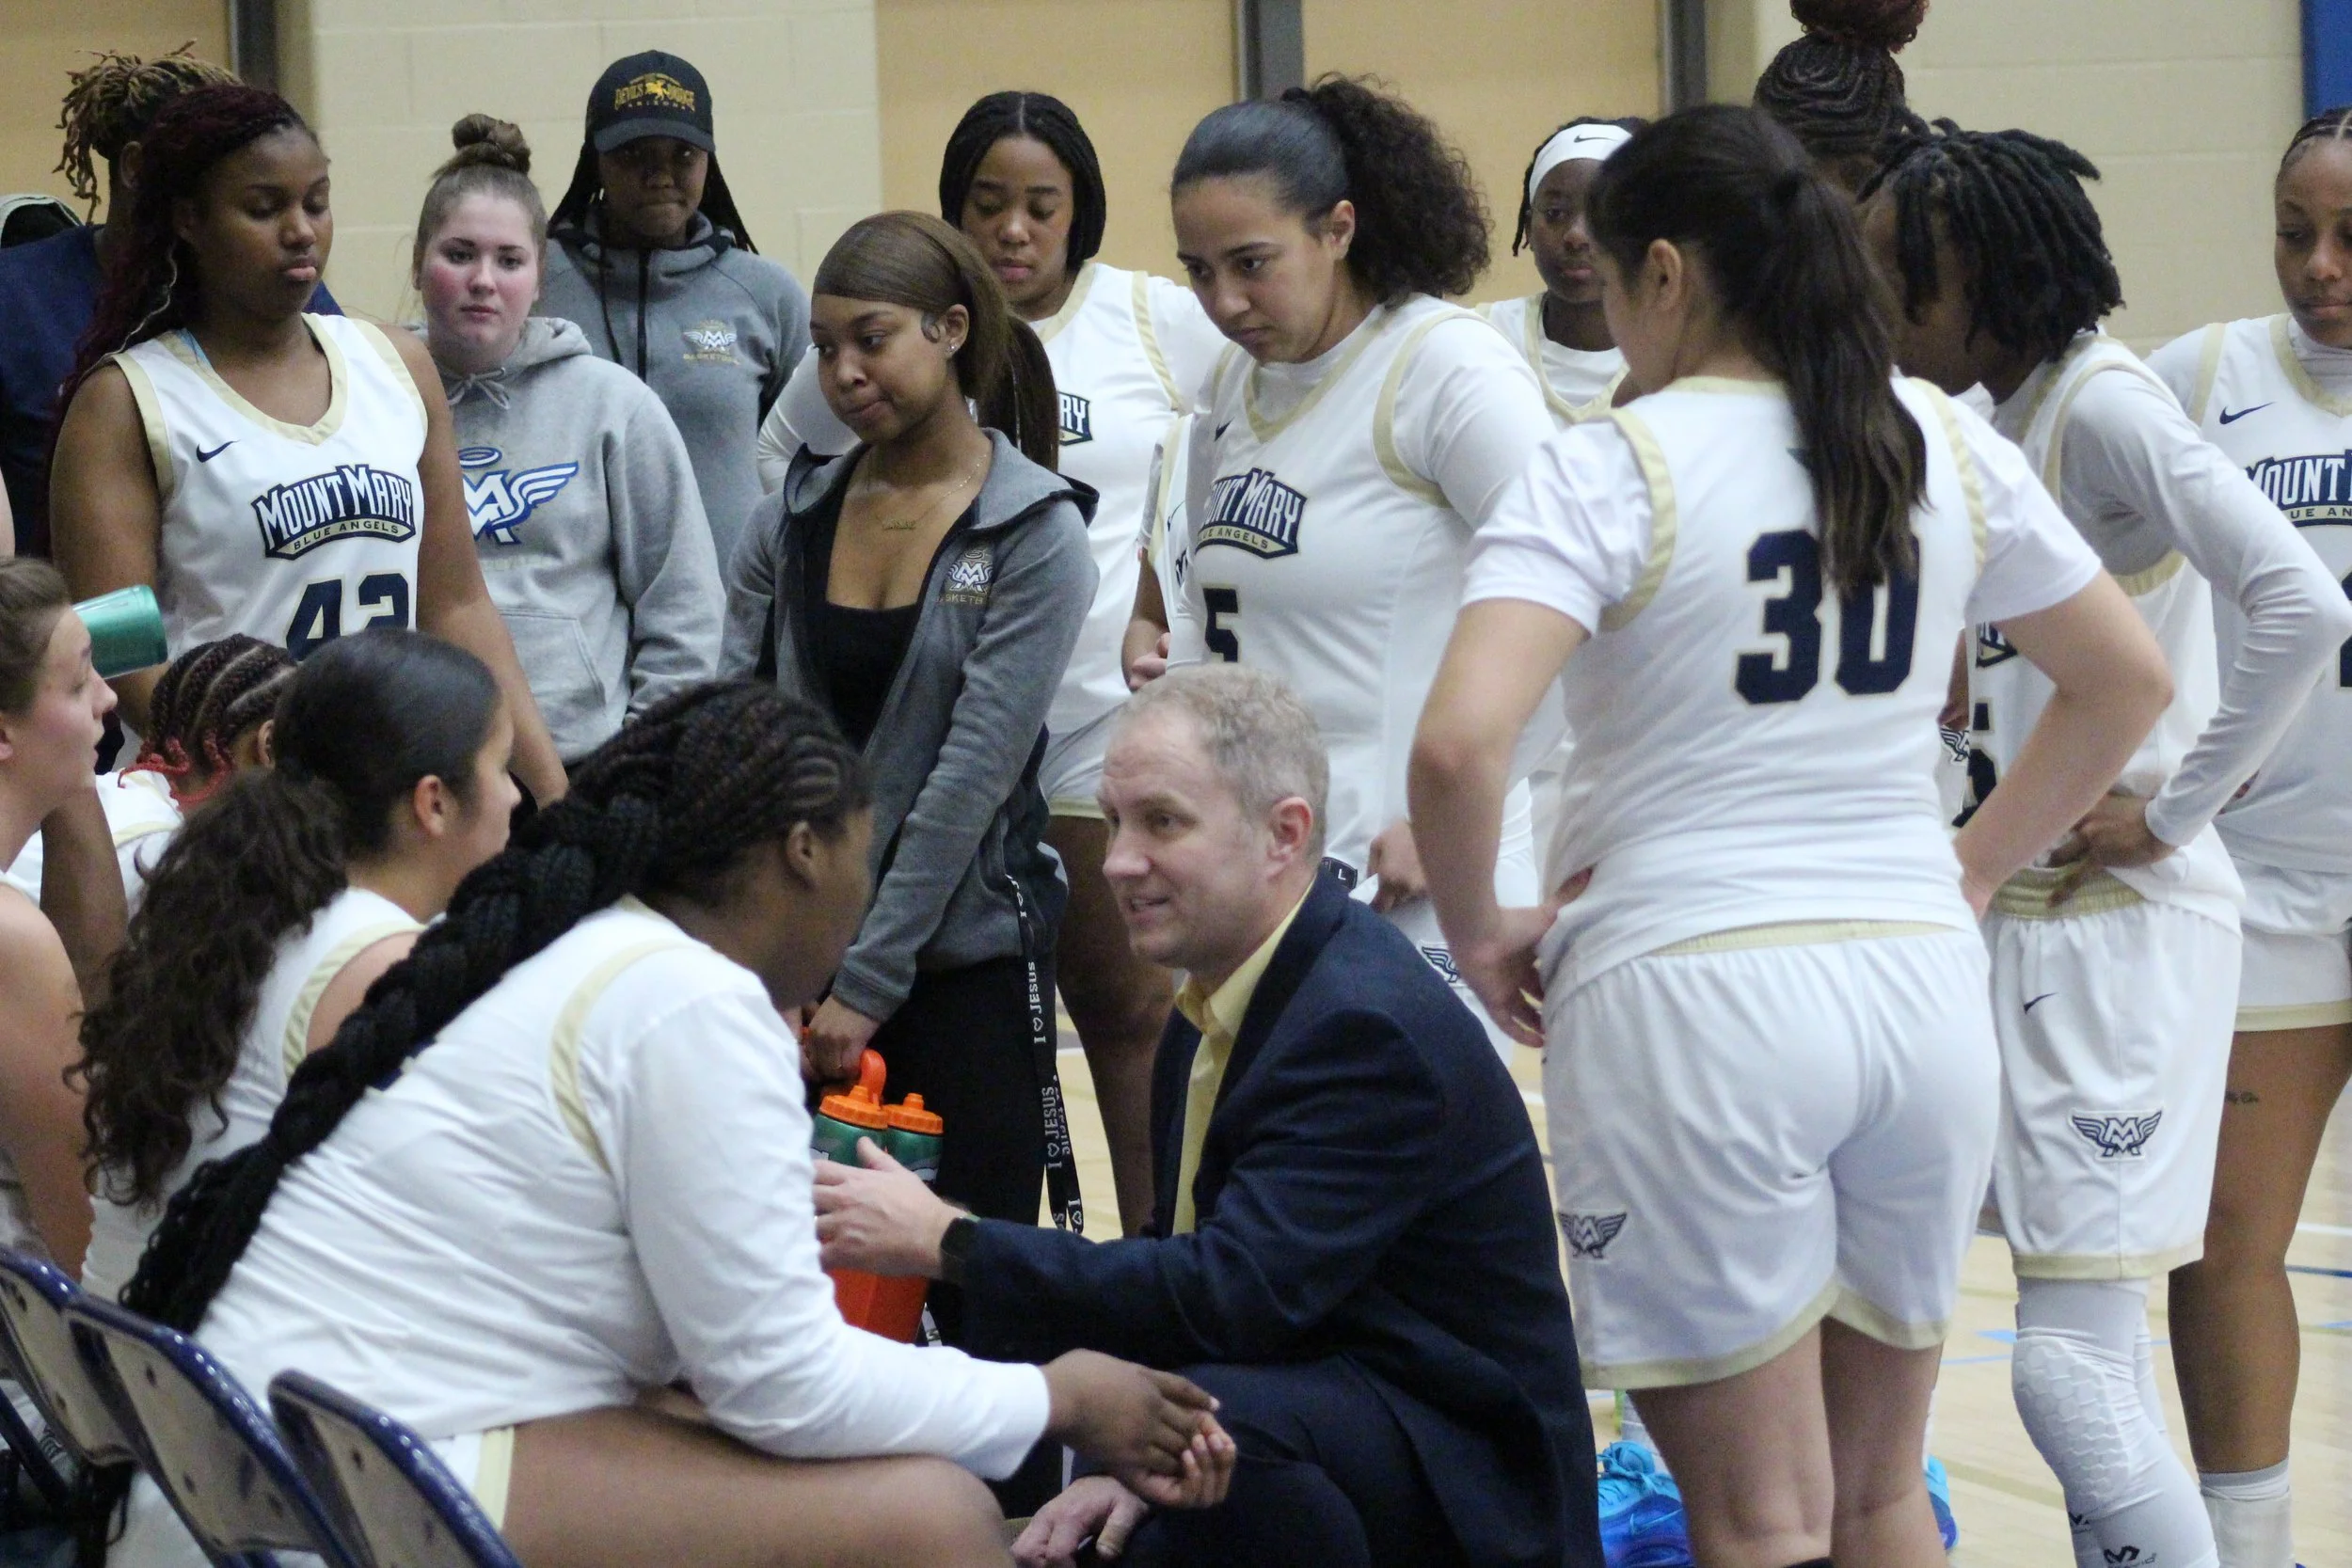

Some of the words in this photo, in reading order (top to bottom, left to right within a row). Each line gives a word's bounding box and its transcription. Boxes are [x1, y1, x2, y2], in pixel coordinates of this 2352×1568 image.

[1059, 393, 1087, 434] RY
[256, 474, 343, 550] MOUNT
[342, 467, 413, 526] MARY
[294, 527, 331, 550] BLUE
[339, 519, 400, 534] ANGELS
[1232, 471, 1302, 545] MARY
[2290, 509, 2315, 519] UE
[1217, 527, 1269, 549] ANGELS
[1202, 587, 1240, 663] 5
[1735, 529, 1921, 705] 30
[1027, 960, 1043, 1015] JESUS
[1033, 1035, 1047, 1044] I
[1041, 1085, 1061, 1141] JESUS
